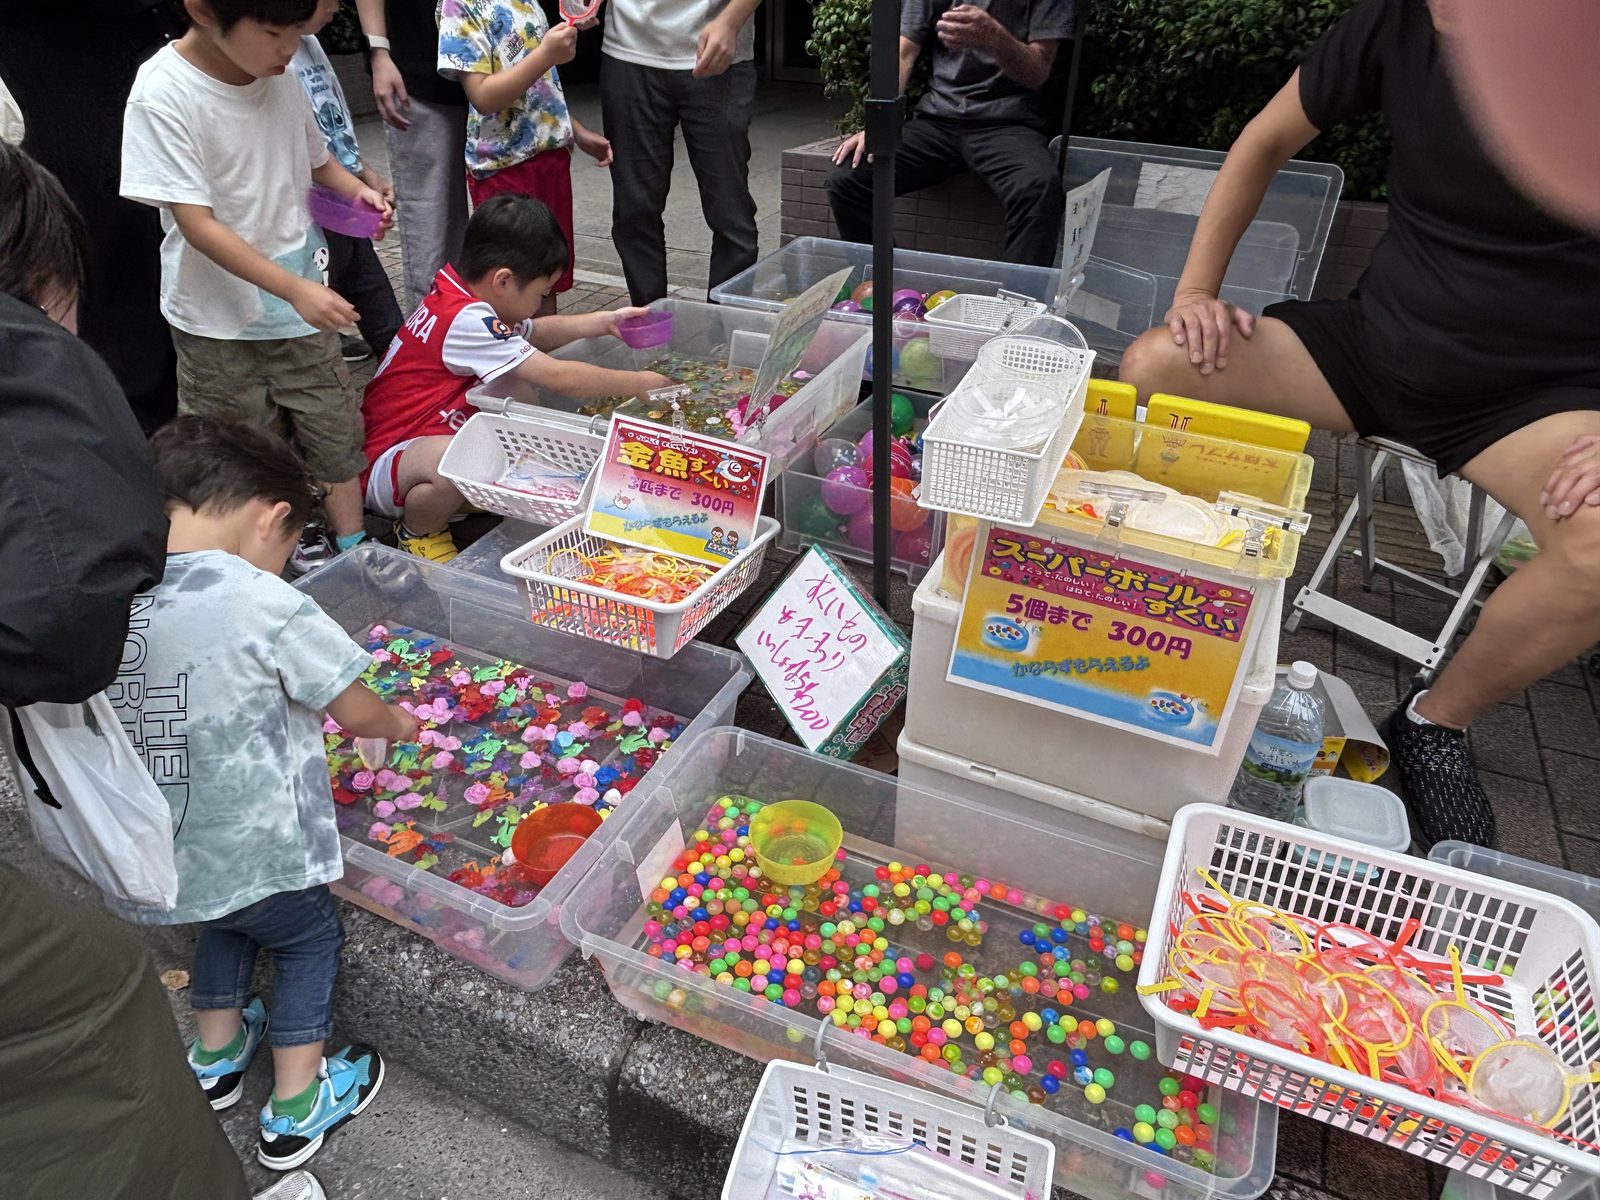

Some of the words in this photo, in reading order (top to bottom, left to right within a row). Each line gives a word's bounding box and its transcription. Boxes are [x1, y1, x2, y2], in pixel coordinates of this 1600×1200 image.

[616, 440, 730, 489] 金魚すくい
[627, 476, 682, 500] 3匹まで
[690, 492, 735, 516] 300円
[991, 536, 1207, 608] スーパーボール
[804, 573, 868, 654] すくいもの
[1004, 593, 1094, 632] 5個まで
[1106, 621, 1194, 661] 300円
[1142, 595, 1240, 634] すくい
[1011, 654, 1151, 678] かならずもらえるよ
[144, 673, 190, 780] THE
